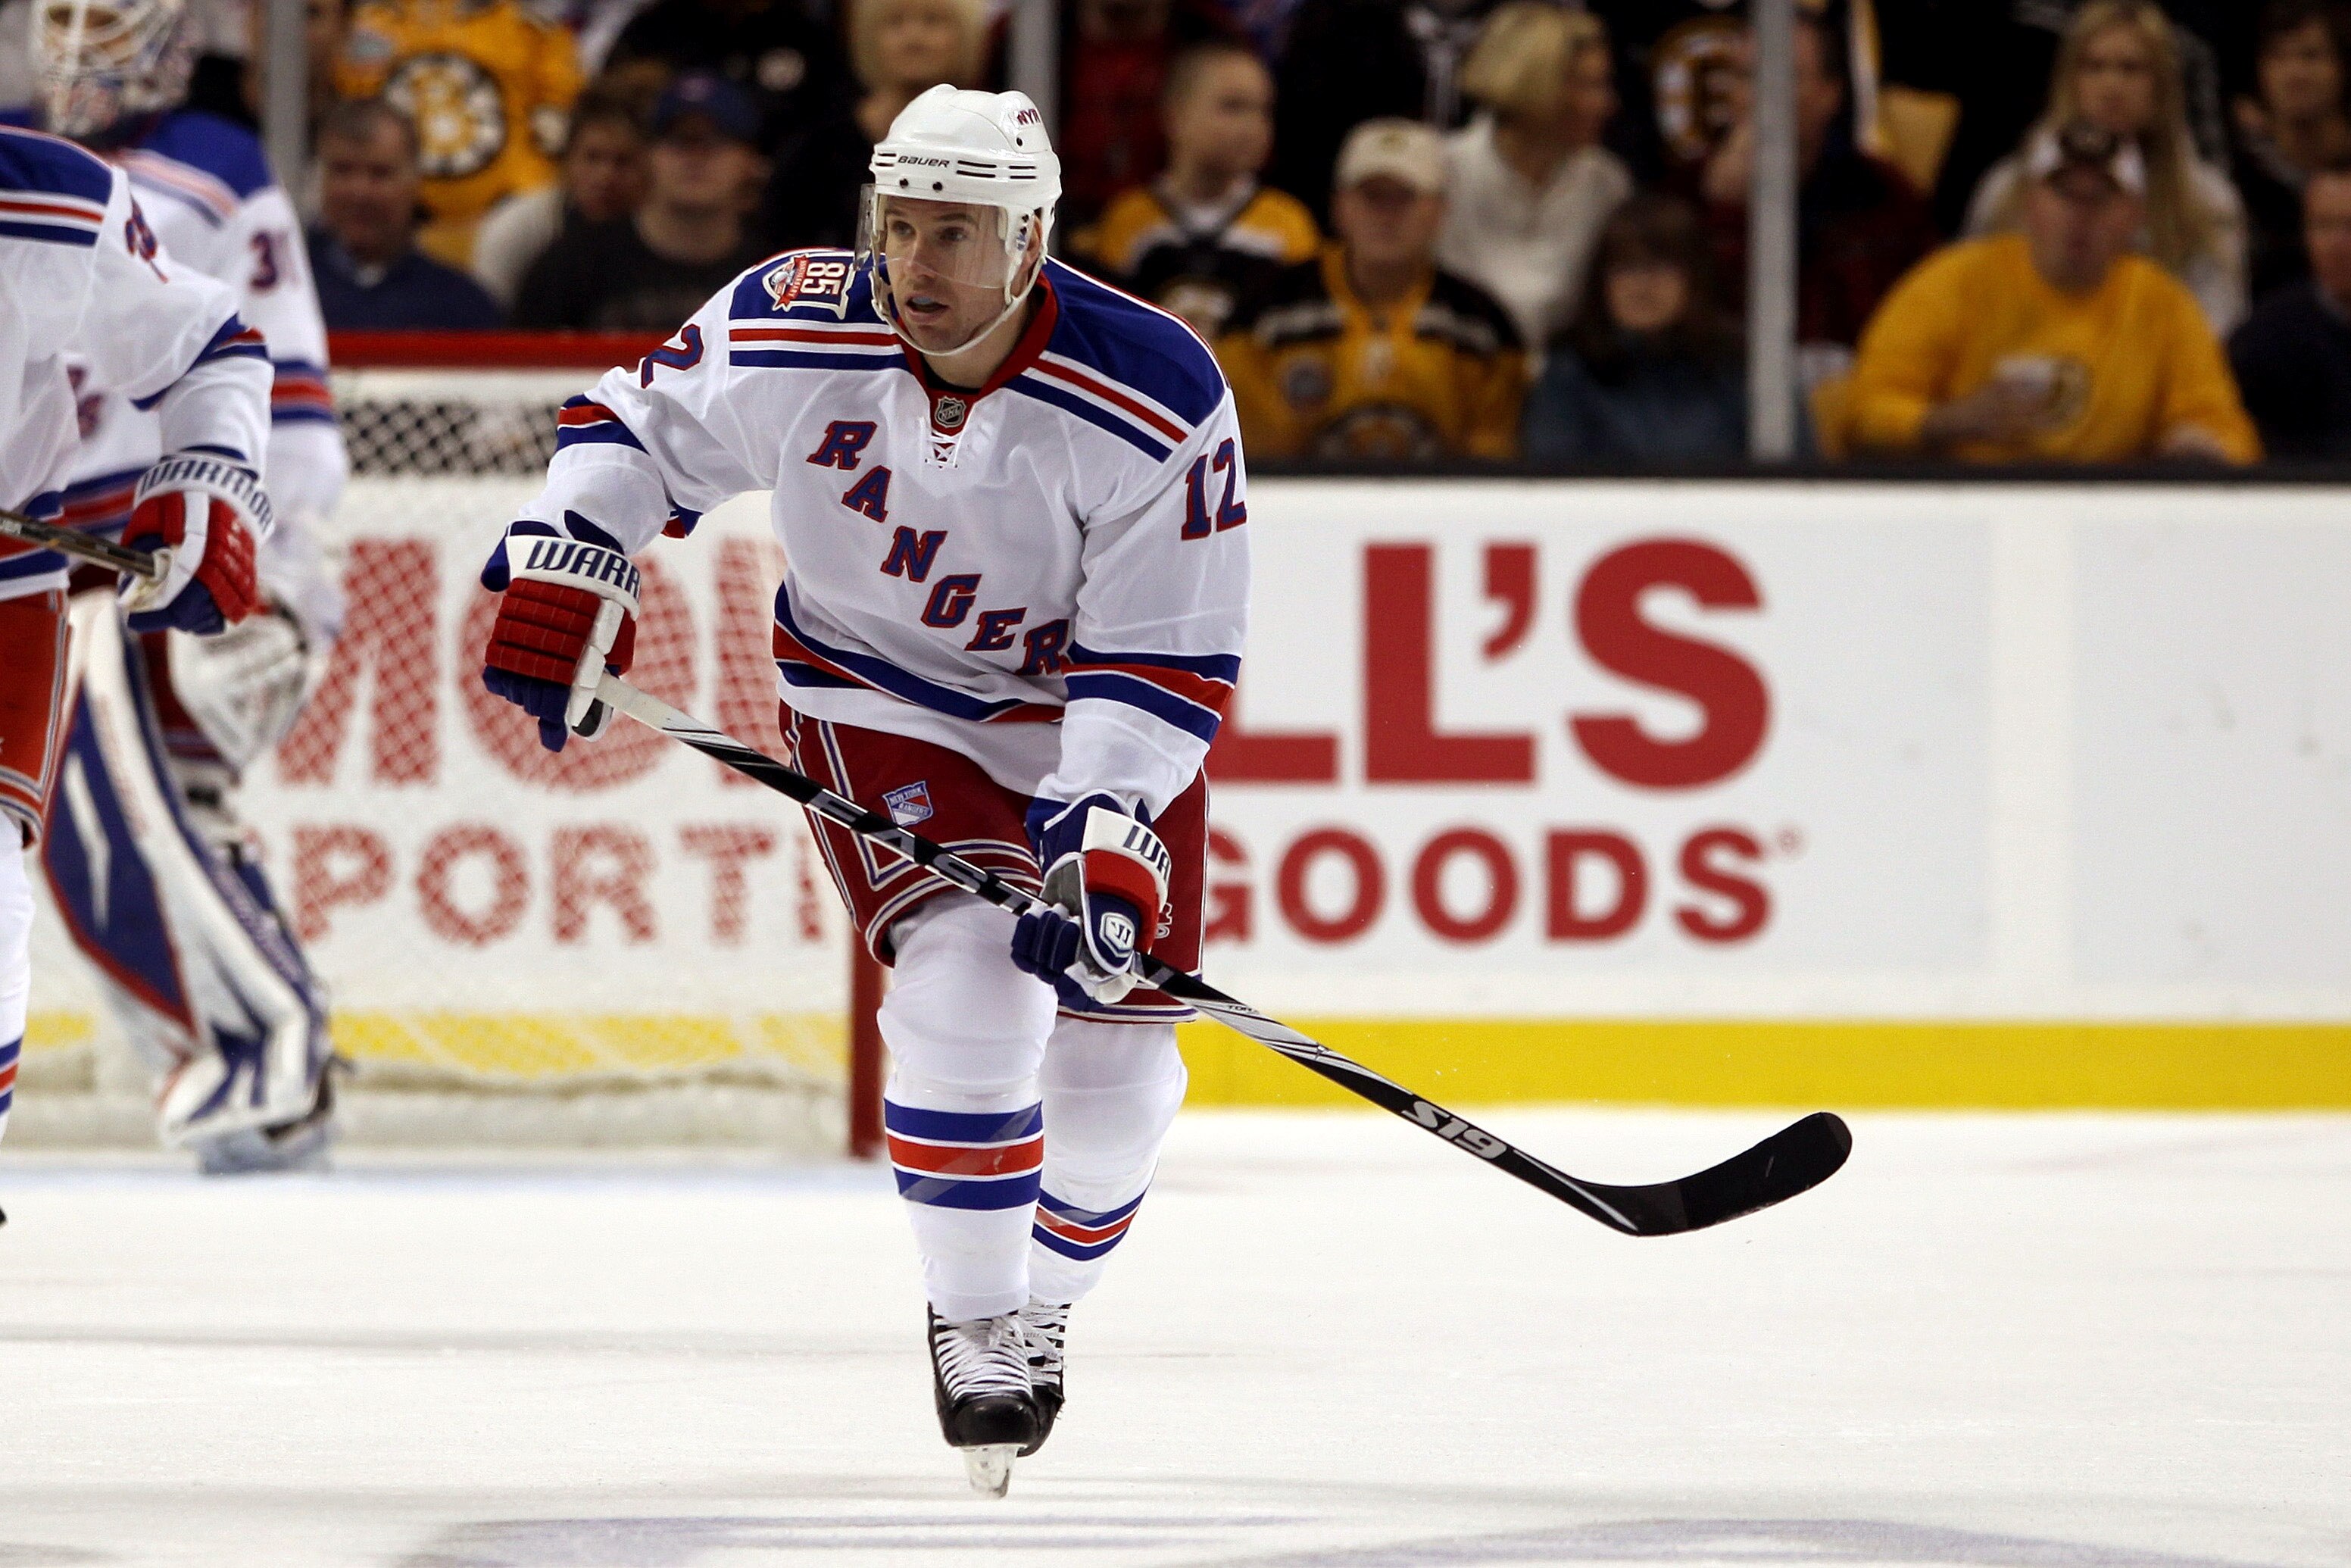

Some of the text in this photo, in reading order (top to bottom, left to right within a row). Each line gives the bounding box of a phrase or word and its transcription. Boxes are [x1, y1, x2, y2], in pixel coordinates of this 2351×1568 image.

[1017, 108, 1041, 126] NYR
[800, 262, 846, 295] 85
[1182, 437, 1247, 540] 12
[1401, 1101, 1507, 1160] S19
